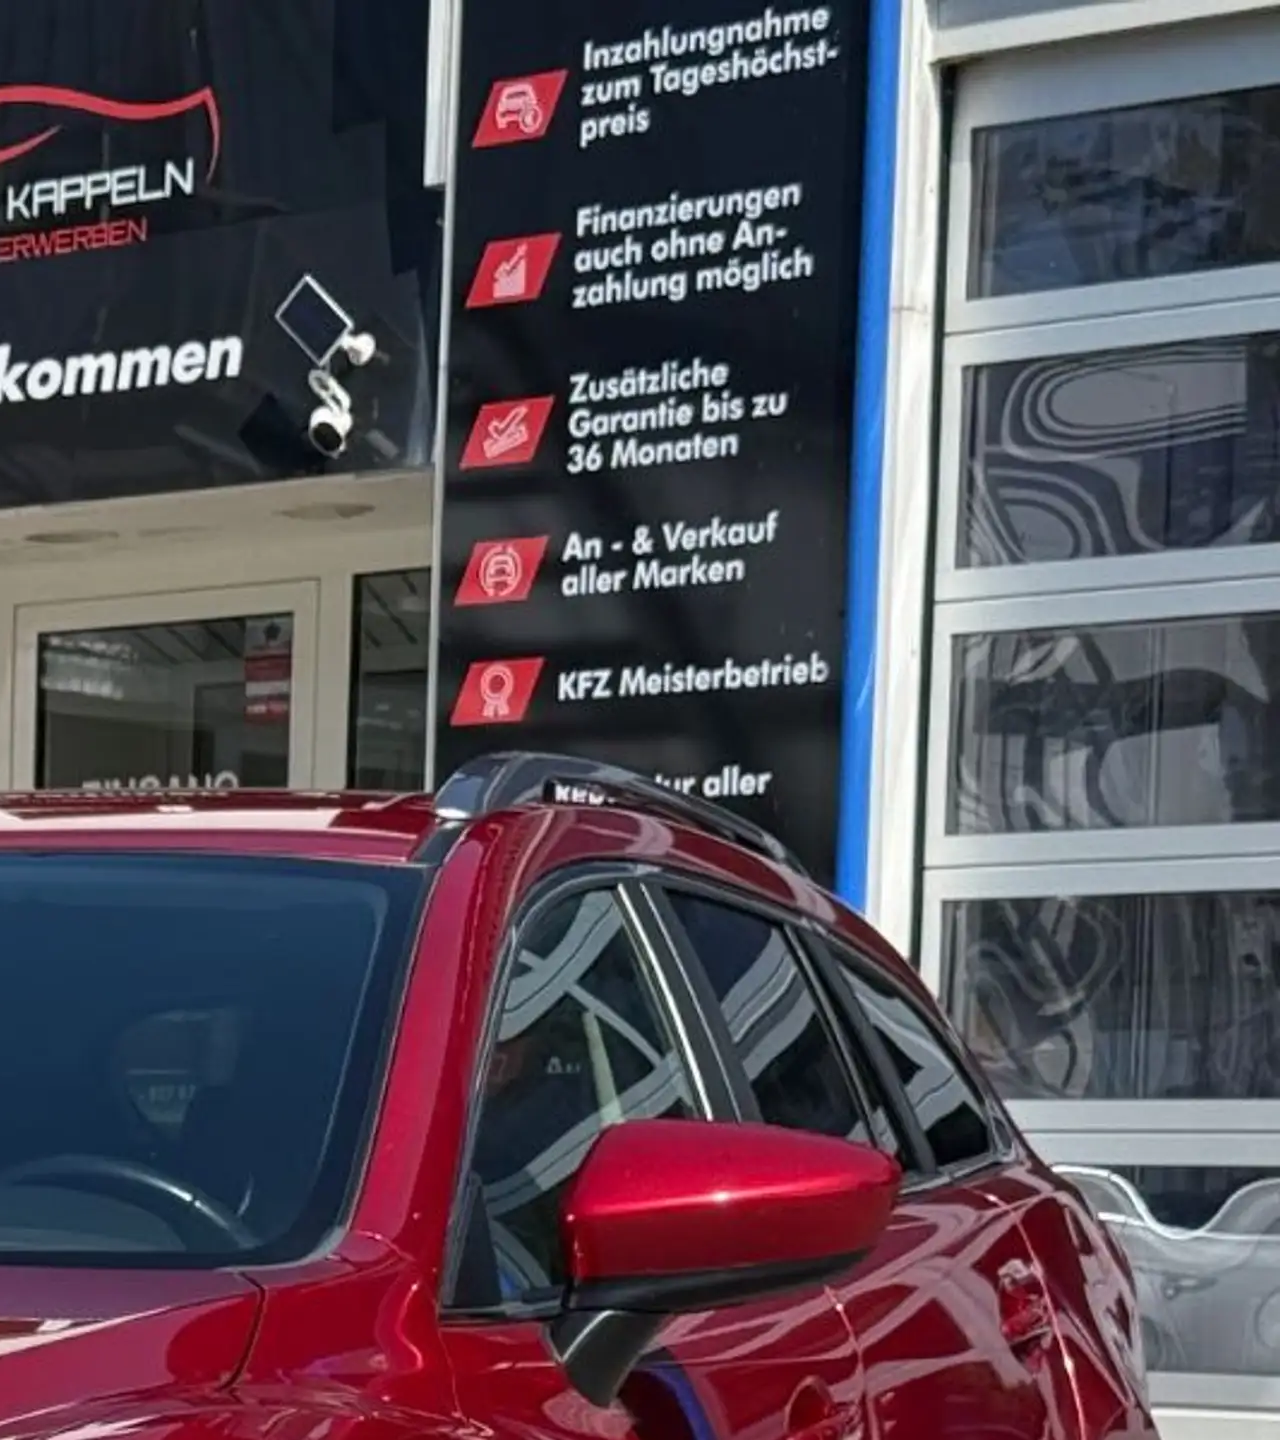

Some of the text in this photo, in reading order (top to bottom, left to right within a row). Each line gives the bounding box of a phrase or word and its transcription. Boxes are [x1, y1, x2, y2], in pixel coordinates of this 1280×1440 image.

[584, 7, 830, 71] Inzahlungnahme
[581, 40, 839, 105] zum Tageshöchst-
[579, 106, 650, 148] preis
[6, 158, 195, 219] KAPPELN
[576, 183, 802, 237] Finanzierungen
[574, 220, 787, 272] auch ohne An-
[572, 248, 814, 308] zahlung möglich
[569, 357, 729, 401] Zusätzliche
[569, 390, 787, 439] Garantie bis zu
[566, 432, 739, 473] 36 Monaten
[632, 524, 654, 554] &
[662, 509, 779, 551] Verkauf
[561, 555, 744, 596] aller Marken
[557, 650, 829, 701] KFZ Meisterbetrieb
[702, 766, 772, 797] aller
